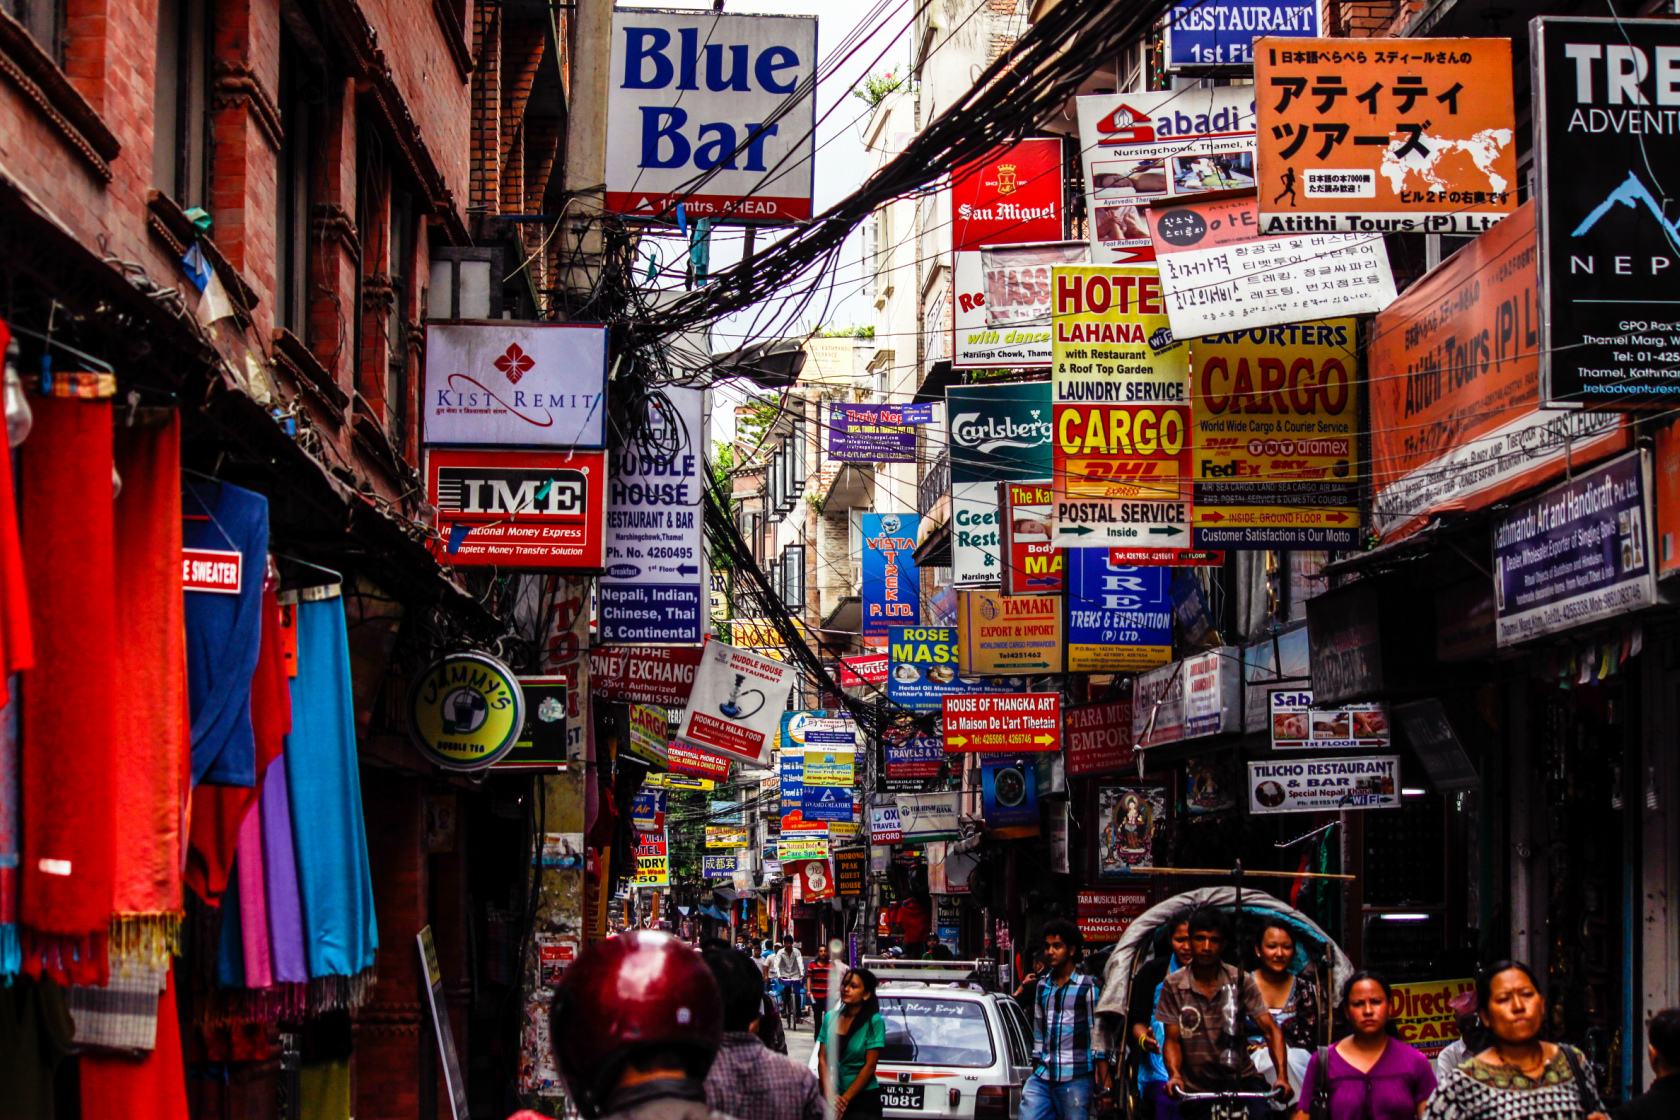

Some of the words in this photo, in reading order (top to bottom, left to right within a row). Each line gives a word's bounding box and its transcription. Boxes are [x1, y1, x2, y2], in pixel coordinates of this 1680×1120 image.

[1174, 6, 1314, 32] RESTAURANT
[620, 27, 800, 93] Blue
[1190, 45, 1223, 62] 1st
[1282, 51, 1367, 64] 日本語ぺらぺら
[1271, 76, 1464, 115] アティティ
[1568, 108, 1680, 134] ADVENT
[638, 106, 778, 172] Bar
[1200, 141, 1243, 151] Thamel,
[1272, 120, 1431, 160] ツアーズ
[723, 201, 777, 214] AHEAD
[958, 202, 994, 222] San
[995, 201, 1056, 223] Miguel
[1269, 216, 1340, 232] Atithi
[1346, 216, 1414, 232] Tours
[1423, 216, 1456, 233] (P)
[1058, 323, 1146, 343] LAHANA
[1619, 321, 1648, 331] GPO
[967, 330, 1000, 345] with
[1004, 329, 1050, 345] dance
[1583, 334, 1628, 345] Thamel
[1631, 335, 1667, 347] Marg,
[998, 350, 1026, 359] Chowk,
[1065, 349, 1088, 359] with
[1090, 349, 1146, 360] Restaurant
[1409, 344, 1446, 420] Atithi
[1450, 325, 1495, 394] Tours
[1500, 294, 1529, 373] (P)
[1613, 352, 1634, 361] Tel:
[1058, 364, 1066, 374] &
[1069, 364, 1093, 374] Roof
[1096, 364, 1114, 376] Top
[1116, 364, 1154, 375] Garden
[1578, 368, 1627, 379] Thamel,
[1058, 381, 1122, 401] LAUNDRY
[1126, 382, 1184, 402] SERVICE
[1201, 356, 1349, 416] CARGO
[437, 390, 494, 407] KIST
[514, 391, 594, 409] REMIT
[952, 412, 1053, 449] Carlsberg
[1058, 408, 1184, 456] CARGO
[1200, 420, 1225, 432] World
[1227, 420, 1247, 432] Wide
[1249, 421, 1275, 435] Cargo
[1284, 421, 1316, 433] Courier
[1317, 421, 1349, 433] Service
[1298, 439, 1348, 455] aramex
[1083, 461, 1160, 483] DHL
[1201, 459, 1263, 478] FedEx
[464, 480, 582, 514] IME
[611, 484, 689, 506] HOUSE
[1012, 488, 1034, 505] The
[1537, 504, 1549, 533] Art
[1550, 493, 1566, 526] and
[1567, 475, 1613, 522] Handicraft
[1614, 484, 1627, 504] Pvt.
[607, 511, 664, 529] RESTAURANT
[675, 511, 694, 529] BAR
[1058, 503, 1117, 523] POSTAL
[1121, 503, 1185, 523] SERVICE
[1228, 513, 1258, 525] INSIDE,
[1259, 513, 1293, 524] GROUND
[1295, 513, 1322, 524] FLOOR
[507, 527, 544, 537] Money
[542, 527, 582, 538] Express
[1107, 527, 1138, 538] Inside
[1201, 528, 1243, 542] Customer
[1244, 528, 1296, 542] Satisfaction
[1298, 529, 1306, 542] is
[1307, 529, 1325, 542] Our
[1326, 529, 1350, 542] Motto
[488, 546, 514, 556] Money
[515, 547, 549, 555] Transfer
[551, 547, 583, 555] Solution
[606, 547, 624, 558] Ph.
[626, 547, 645, 558] No.
[646, 547, 693, 559] 4260495
[1028, 543, 1055, 556] Body
[983, 553, 995, 567] &
[192, 560, 237, 584] SWEATER
[601, 588, 648, 604] Nepali,
[652, 588, 698, 603] Indian,
[603, 607, 662, 622] Chinese,
[665, 606, 695, 620] Thai
[870, 603, 887, 617] P.
[885, 603, 914, 617] LTD.
[1003, 599, 1054, 615] TAMAKI
[1071, 611, 1102, 628] TREKS
[1113, 612, 1171, 629] EXPEDITION
[603, 627, 614, 639] &
[617, 626, 696, 639] Continental
[903, 628, 950, 642] ROSE
[980, 626, 1012, 637] EXPORT
[1024, 625, 1055, 636] IMPORT
[1101, 631, 1117, 642] (P)
[1119, 631, 1142, 642] LTD.
[731, 653, 759, 669] HUDDLE
[759, 662, 784, 677] HOUSE
[729, 663, 781, 684] RESTAURANT
[628, 682, 677, 694] Authorized
[946, 698, 977, 712] HOUSE
[979, 698, 991, 711] OF
[992, 698, 1036, 711] THANGKA
[1037, 697, 1056, 711] ART
[630, 704, 668, 739] CARGO
[694, 714, 720, 731] HOOKAH
[947, 717, 957, 730] La
[959, 716, 988, 730] Maison
[989, 716, 1000, 729] De
[1002, 715, 1021, 729] L'art
[1022, 715, 1056, 729] Tibetain
[1073, 707, 1104, 728] TARA
[1321, 739, 1357, 747] FLOOR
[889, 749, 924, 758] TRAVELS
[1254, 764, 1304, 777] TILICHO
[1307, 761, 1394, 775] RESTAURANT
[1307, 777, 1350, 787] BAR
[1289, 789, 1318, 799] Special
[1319, 788, 1345, 798] Nepali
[873, 832, 900, 841] OXFORD
[1077, 895, 1093, 904] TARA
[1093, 895, 1118, 904] MUSICAL
[1118, 895, 1146, 904] EMPORIUM
[1390, 986, 1453, 1018] Direct
